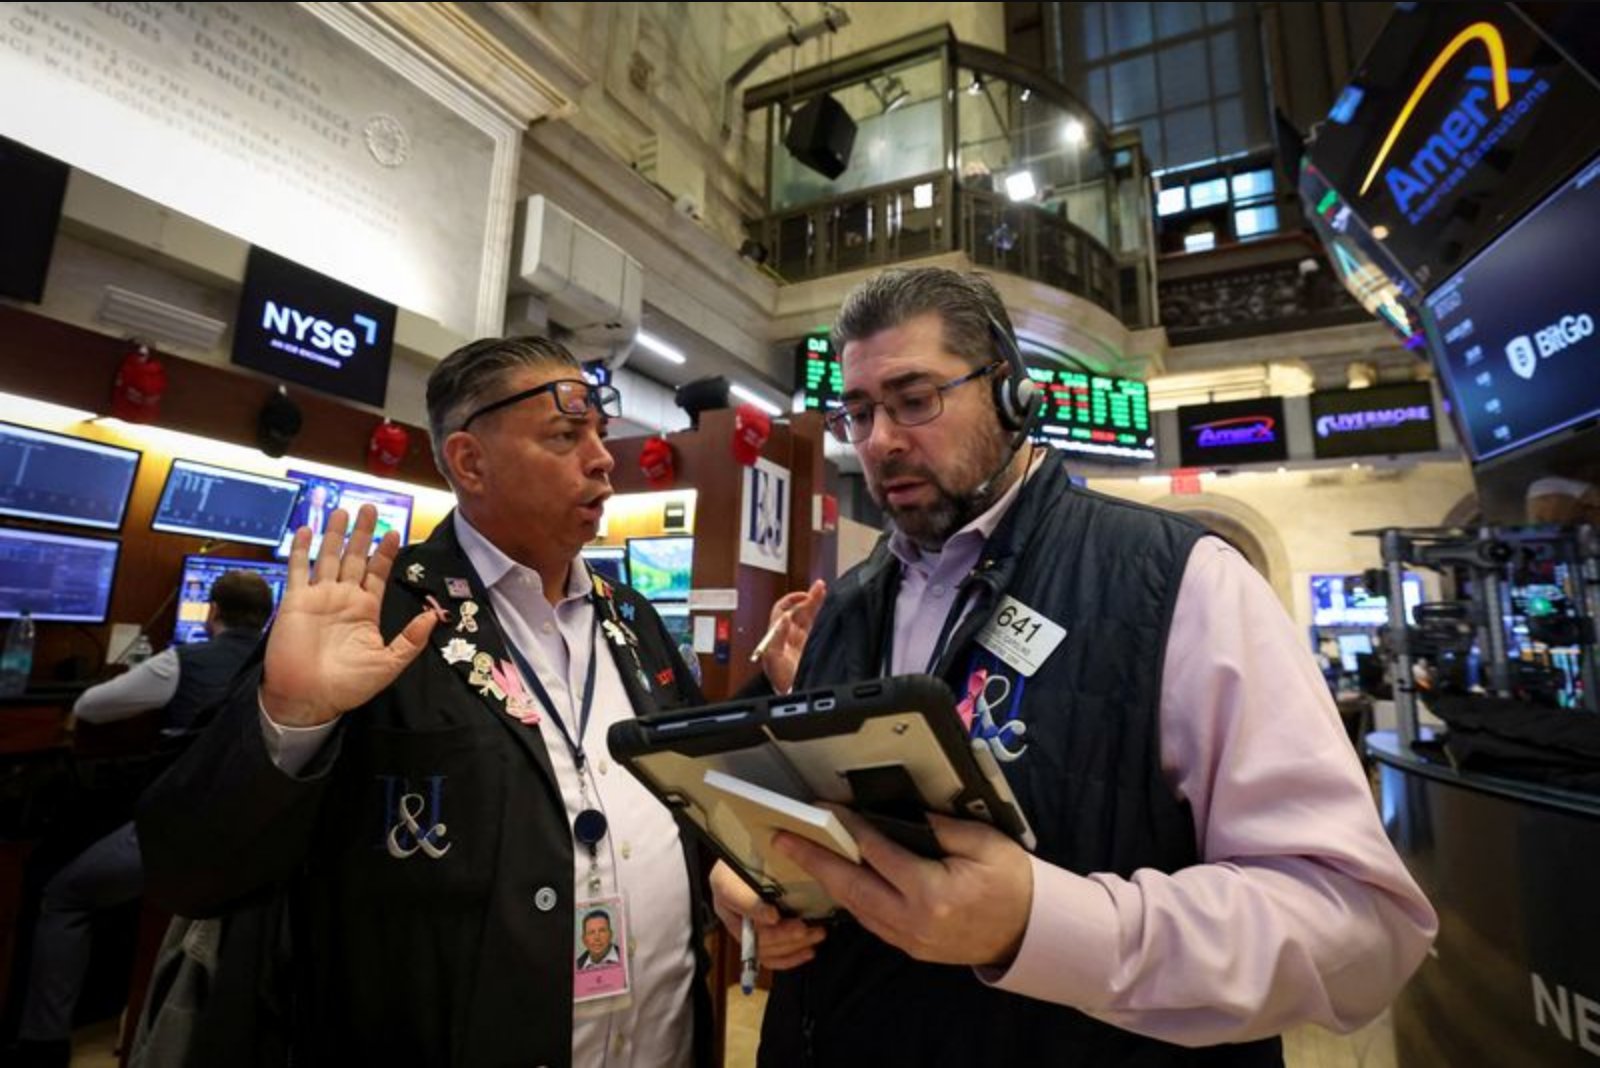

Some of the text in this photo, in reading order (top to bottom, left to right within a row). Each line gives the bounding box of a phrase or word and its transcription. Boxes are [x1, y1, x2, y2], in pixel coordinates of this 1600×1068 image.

[23, 4, 119, 67] MEMBERS
[158, 74, 190, 100] THE
[191, 50, 266, 102] SAMUEL
[194, 30, 259, 79] ERNEST
[221, 28, 322, 96] CHAIRMAN
[1384, 65, 1534, 216] AmerX
[1534, 312, 1594, 359] BitGo
[996, 605, 1043, 644] 641
[1530, 971, 1600, 1058] NE
